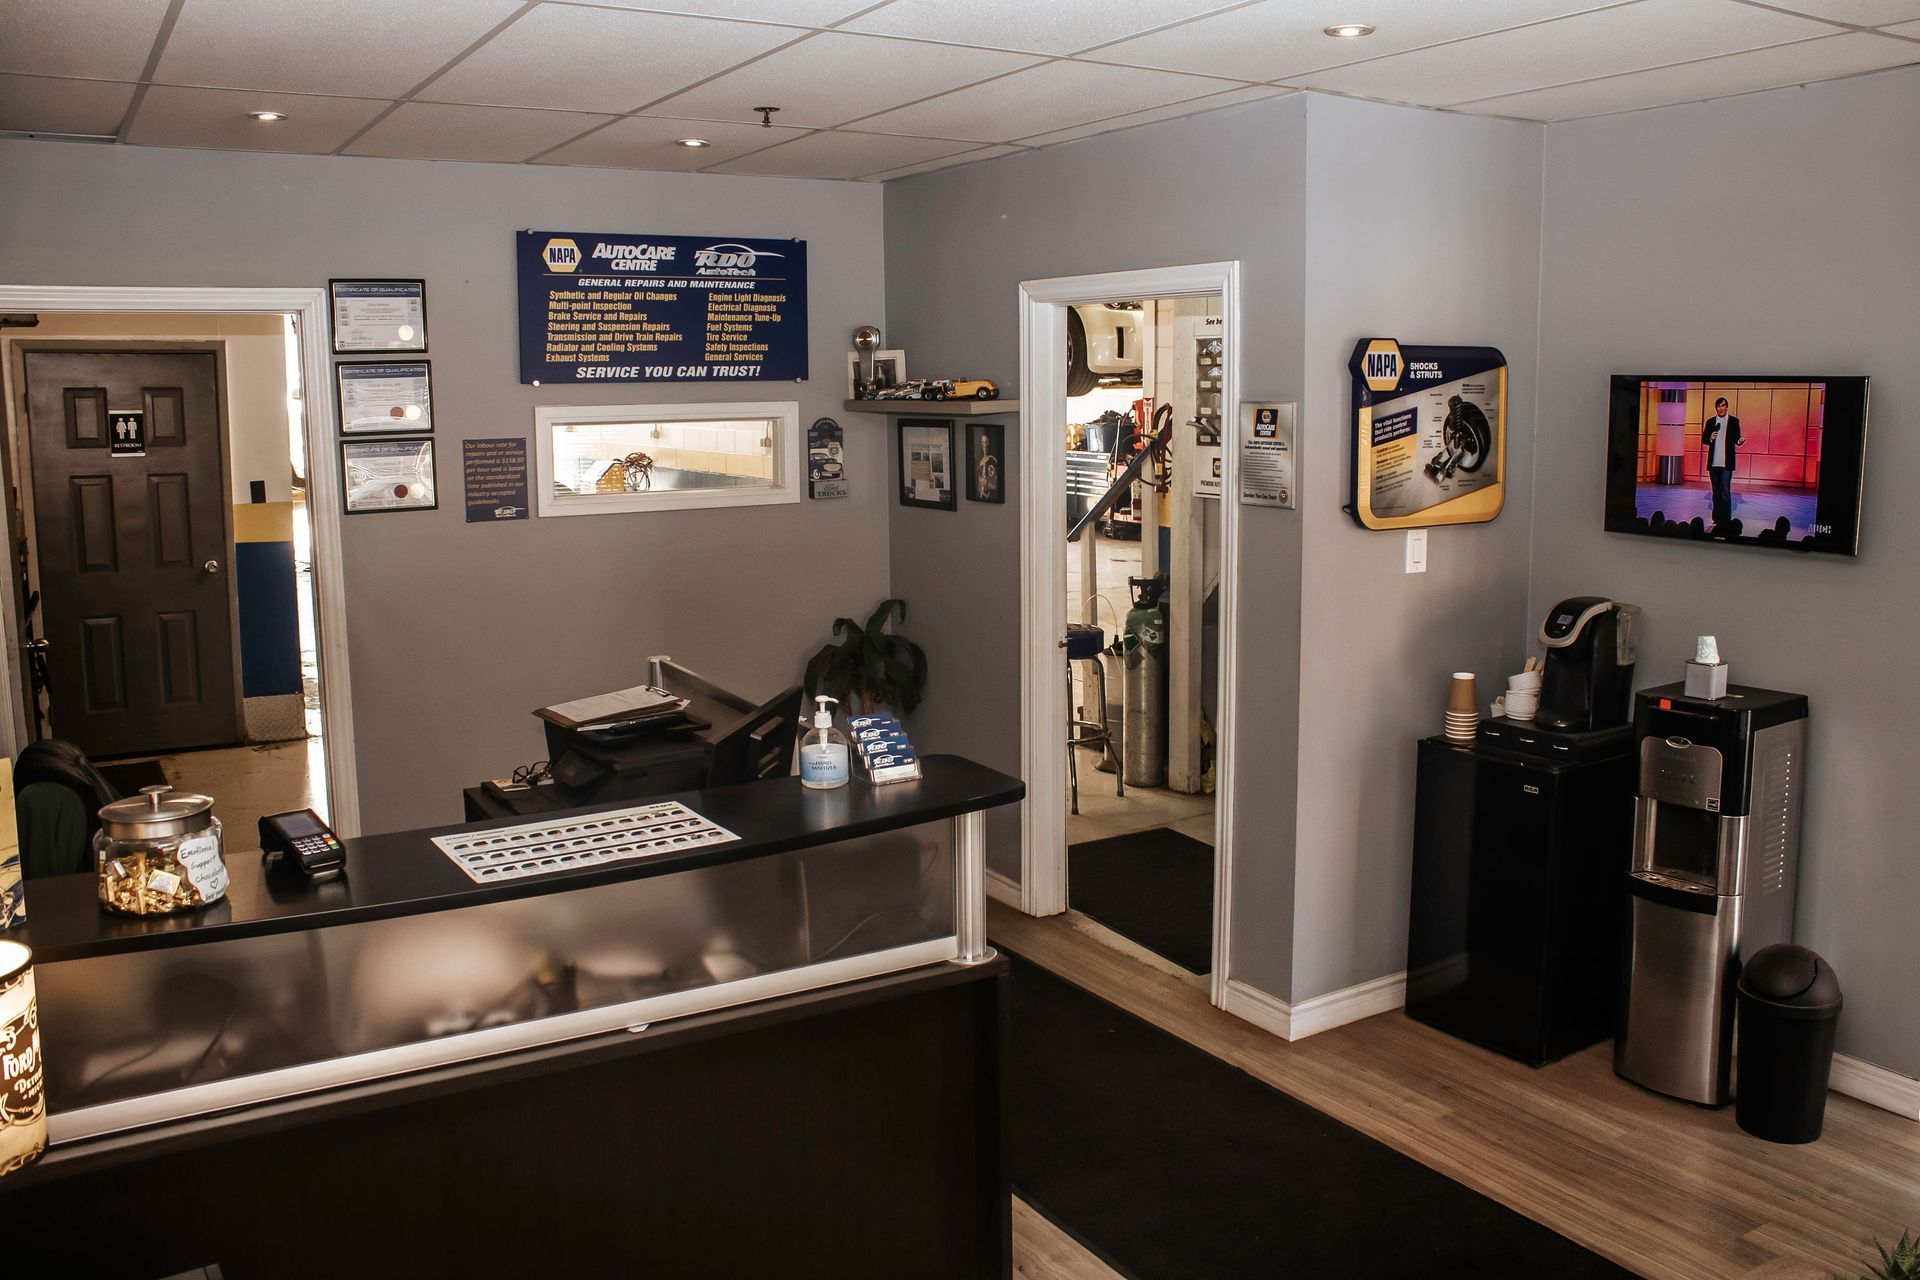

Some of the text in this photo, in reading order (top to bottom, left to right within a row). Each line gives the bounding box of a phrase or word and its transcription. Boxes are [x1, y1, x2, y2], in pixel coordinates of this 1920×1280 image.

[549, 247, 576, 264] NAPA
[694, 251, 756, 268] RDO
[610, 259, 658, 272] CENTRE
[696, 267, 757, 277] AutoTech
[578, 278, 756, 289] GENERAL REPAIRS AND MAINTENANCE
[550, 291, 677, 301] Synthetic and Regular Oil Changes
[709, 293, 786, 302] Engine Light Diagnosis
[549, 302, 631, 311] Multi-point Inspection
[708, 303, 776, 312] Electrical Diagnosis
[549, 312, 647, 321] Brake Service and Repairs
[708, 313, 781, 322] Maintenance Tune-Up
[548, 322, 579, 331] Steering
[598, 323, 640, 332] Suspension
[643, 323, 670, 332] Repairs
[707, 323, 752, 332] Fuel Systems
[548, 333, 682, 342] Transmission and Drive Train Repairs
[707, 333, 747, 341] Tire Service
[547, 343, 657, 352] Radiator and Cooling Systems
[706, 343, 768, 352] Safety Inspections
[546, 354, 609, 363] Exhaust Systems
[705, 353, 763, 361] General Services
[1368, 354, 1397, 377] NAPA
[576, 366, 761, 378] SERVICE YOU CAN TRUST!
[1410, 371, 1415, 379] &
[1393, 414, 1411, 423] functions
[1393, 421, 1407, 430] control
[1375, 432, 1392, 443] products
[816, 489, 847, 497] TRUCKS
[181, 839, 214, 859] Emotional
[3, 1046, 32, 1080] FORD
